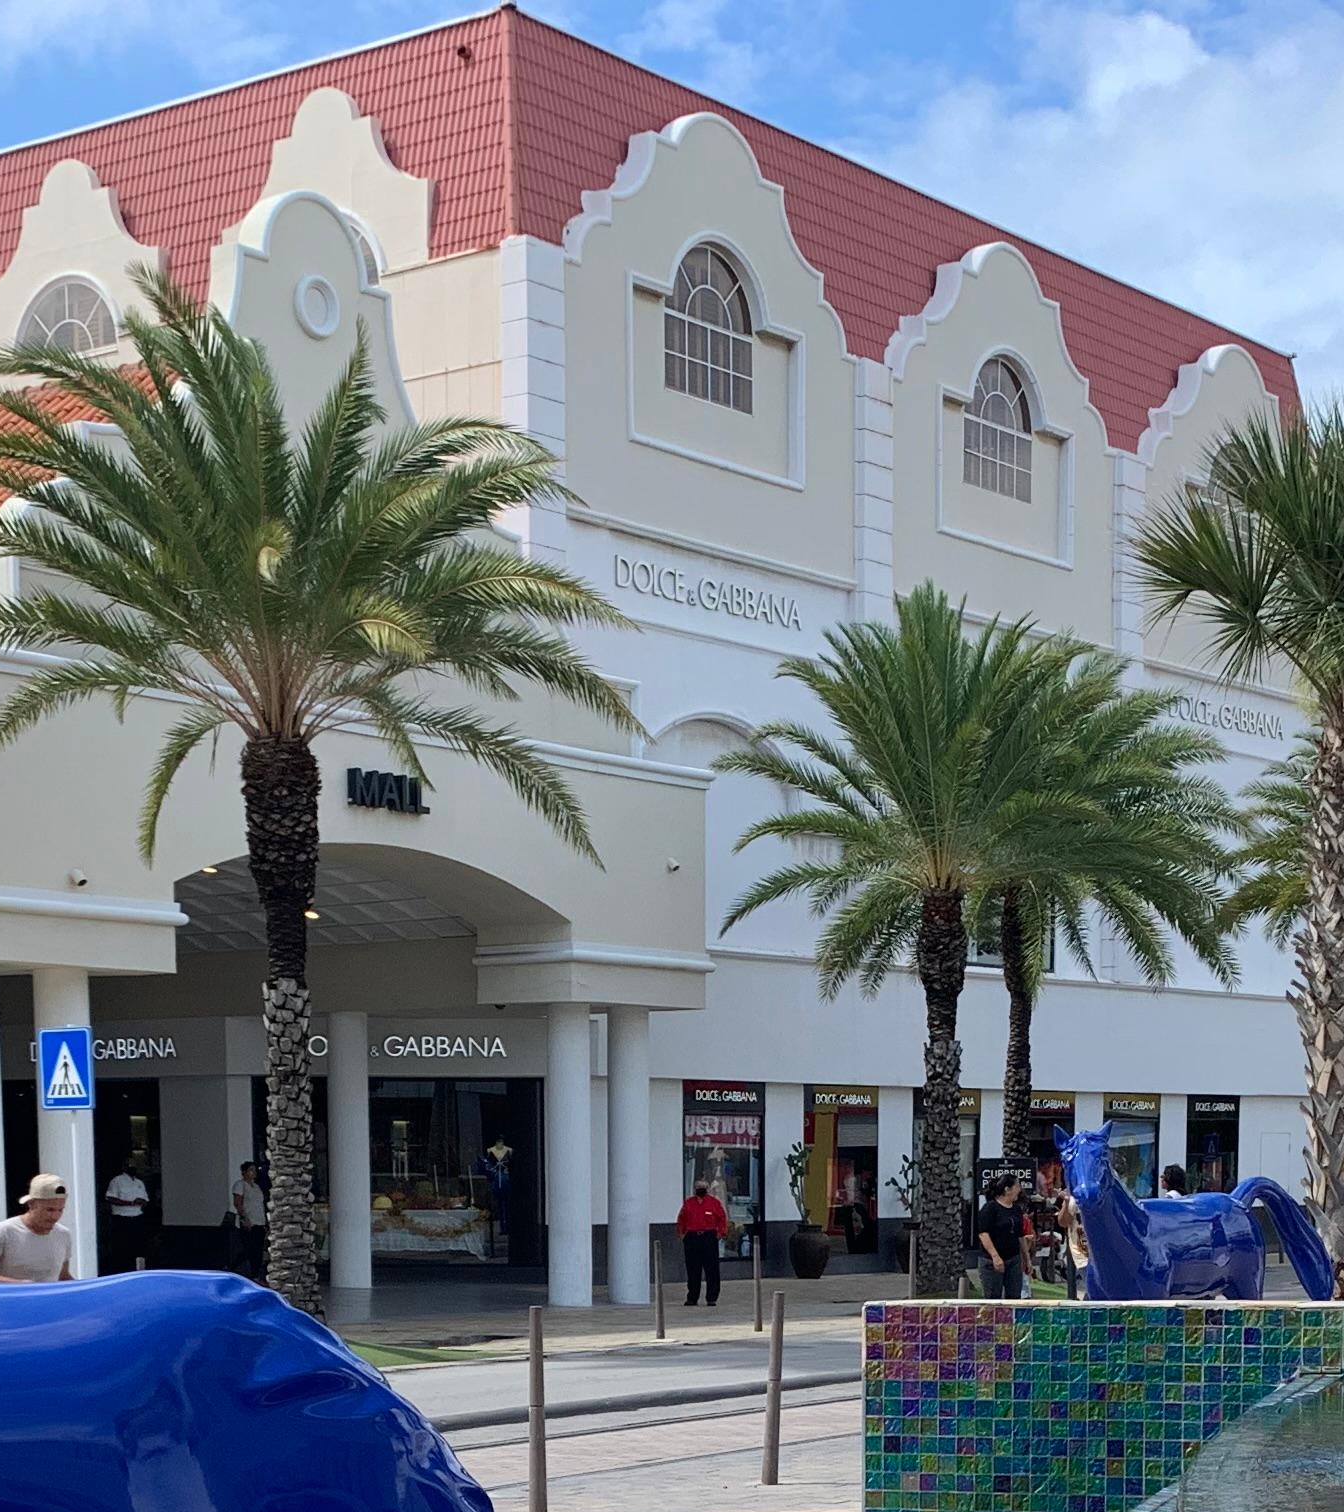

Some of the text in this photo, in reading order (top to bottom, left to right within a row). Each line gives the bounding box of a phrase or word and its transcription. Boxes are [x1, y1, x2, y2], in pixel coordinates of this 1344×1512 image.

[614, 554, 686, 603] DOLCE
[698, 577, 802, 631] GABBANA
[1218, 703, 1284, 740] GABBANA
[347, 768, 430, 814] MALL
[92, 1037, 177, 1060] GABBANA
[369, 1035, 507, 1057] & GABBANA
